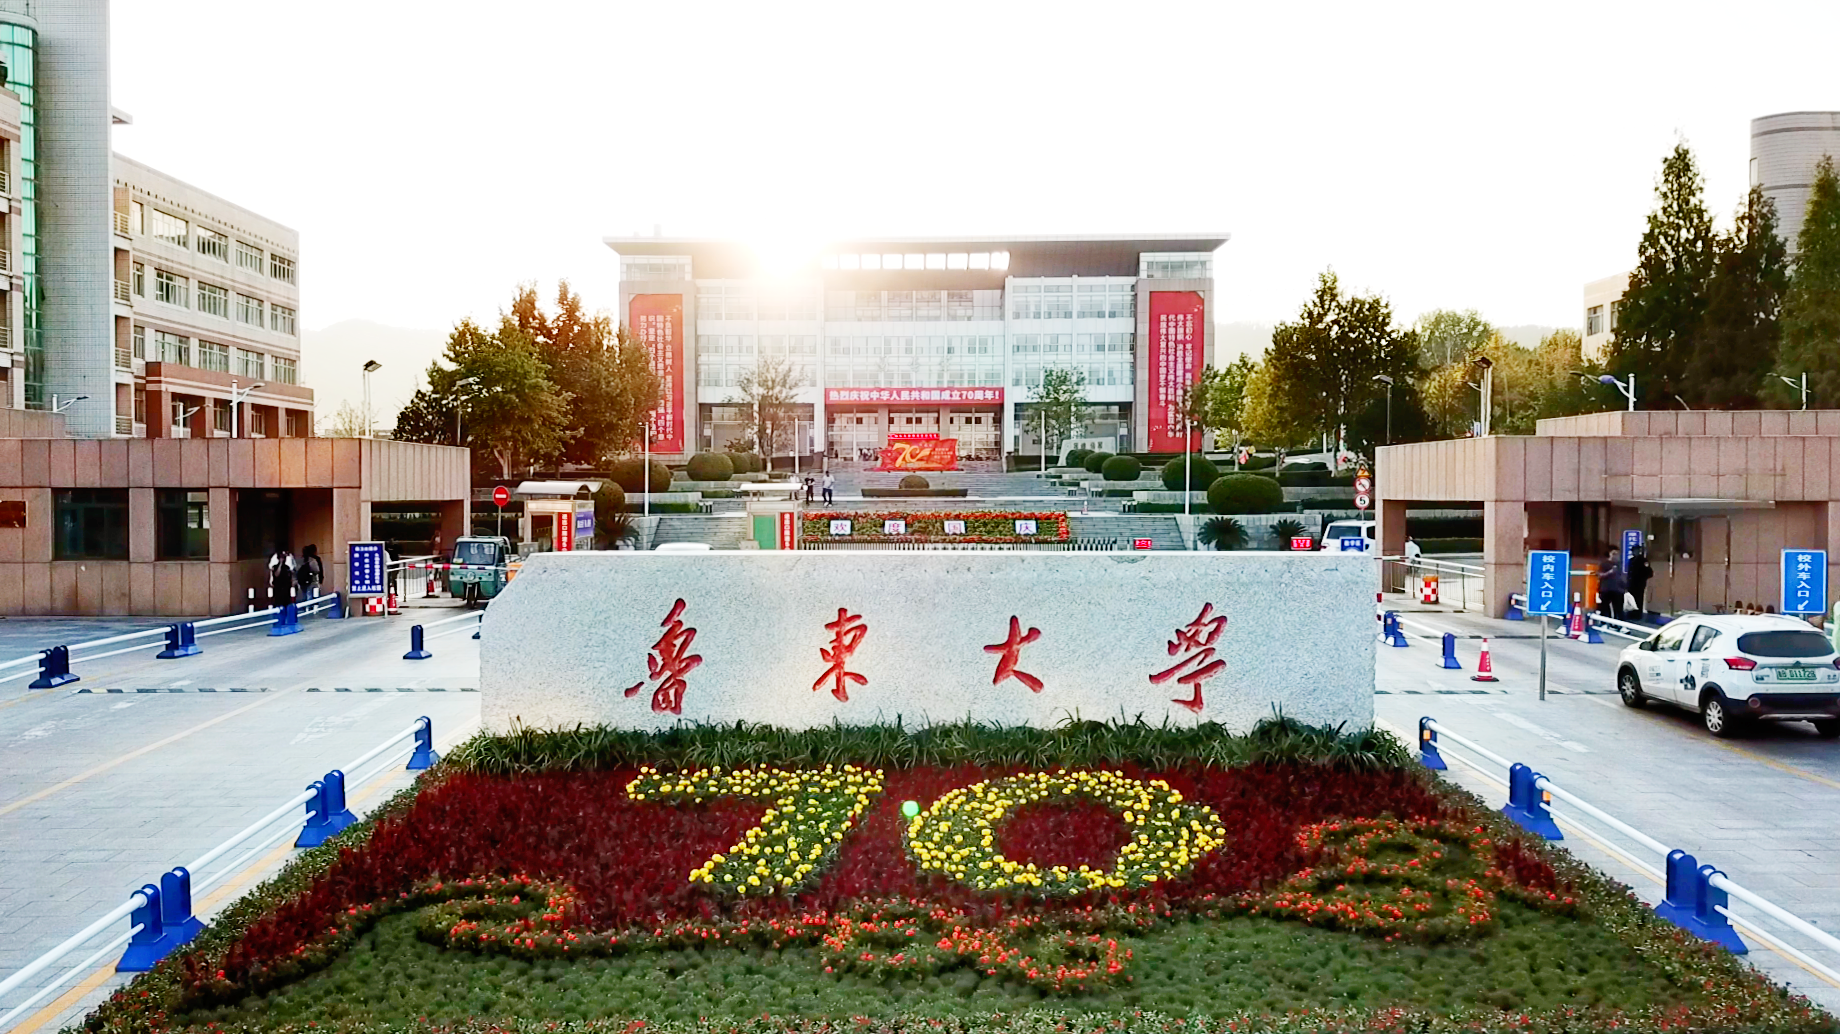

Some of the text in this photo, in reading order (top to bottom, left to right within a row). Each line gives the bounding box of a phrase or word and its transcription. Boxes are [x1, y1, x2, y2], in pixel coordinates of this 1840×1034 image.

[1185, 313, 1194, 341] 不忘初心
[1185, 343, 1193, 370] 牢记使命
[1359, 496, 1366, 506] 5
[1540, 554, 1556, 598] 校内车入口
[1796, 554, 1812, 598] 校外车入口
